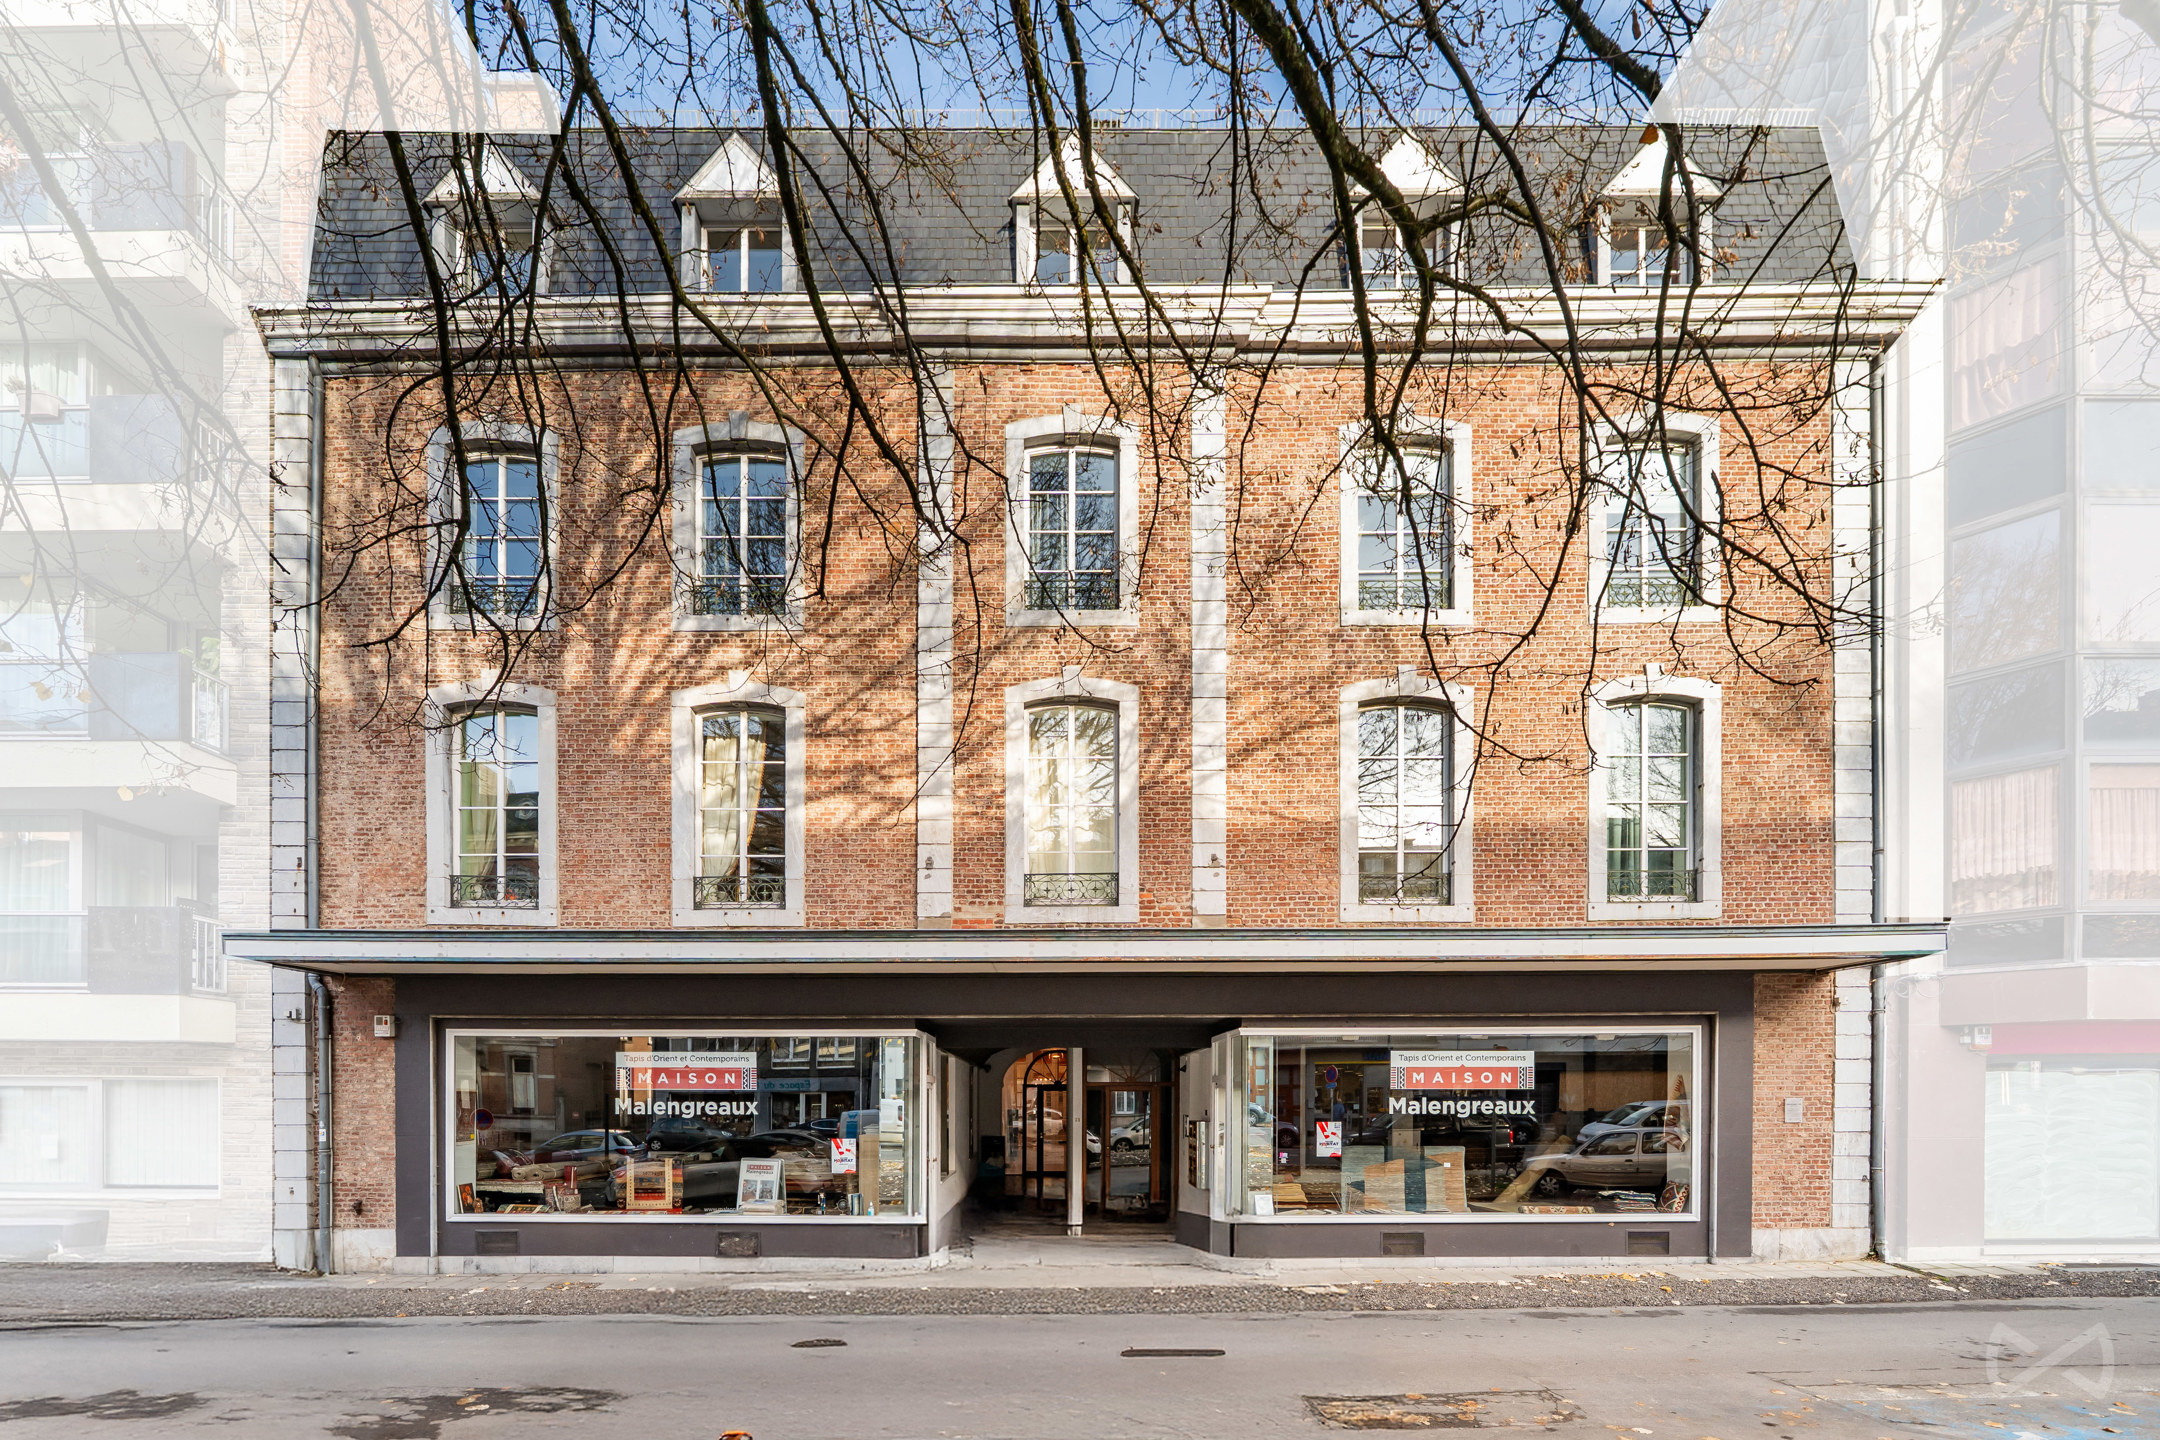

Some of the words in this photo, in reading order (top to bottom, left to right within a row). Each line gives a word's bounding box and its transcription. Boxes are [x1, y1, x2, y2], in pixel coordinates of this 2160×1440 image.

[624, 1054, 647, 1063] Tapis
[647, 1054, 678, 1062] d'Orient
[689, 1054, 750, 1064] Contemporains
[1399, 1054, 1420, 1063] Tapis
[1421, 1054, 1454, 1062] d'Orient
[1455, 1054, 1464, 1062] et
[1465, 1054, 1527, 1063] Contemporains
[637, 1072, 736, 1085] MAISON
[1412, 1072, 1512, 1084] MAISON
[614, 1097, 759, 1119] Malengreaux
[1388, 1097, 1536, 1118] Malengreaux
